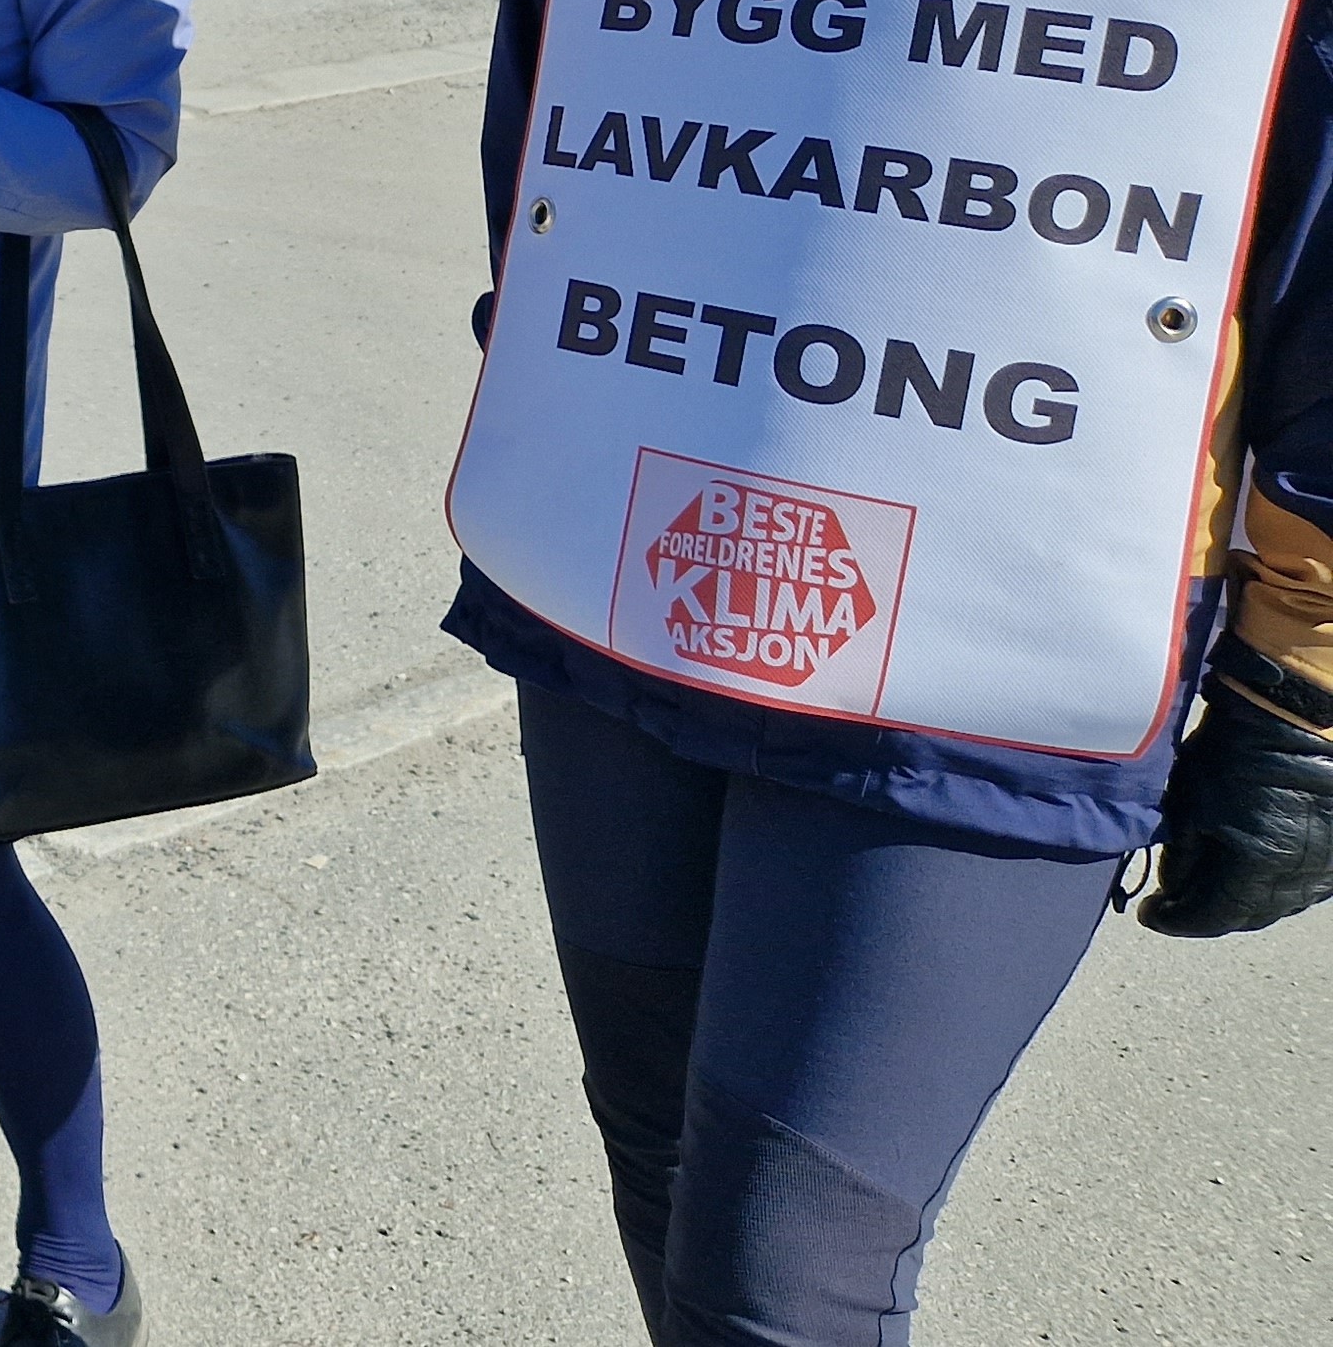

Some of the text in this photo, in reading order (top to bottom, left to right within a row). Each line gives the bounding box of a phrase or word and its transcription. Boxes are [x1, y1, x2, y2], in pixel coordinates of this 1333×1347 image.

[543, 106, 1203, 262] LAVKARBON
[557, 278, 1080, 445] BETONG
[699, 483, 826, 547] BESTE
[659, 532, 858, 589] FORELDRENES
[656, 557, 857, 637] KLIMA
[669, 621, 829, 671] AKSJON
